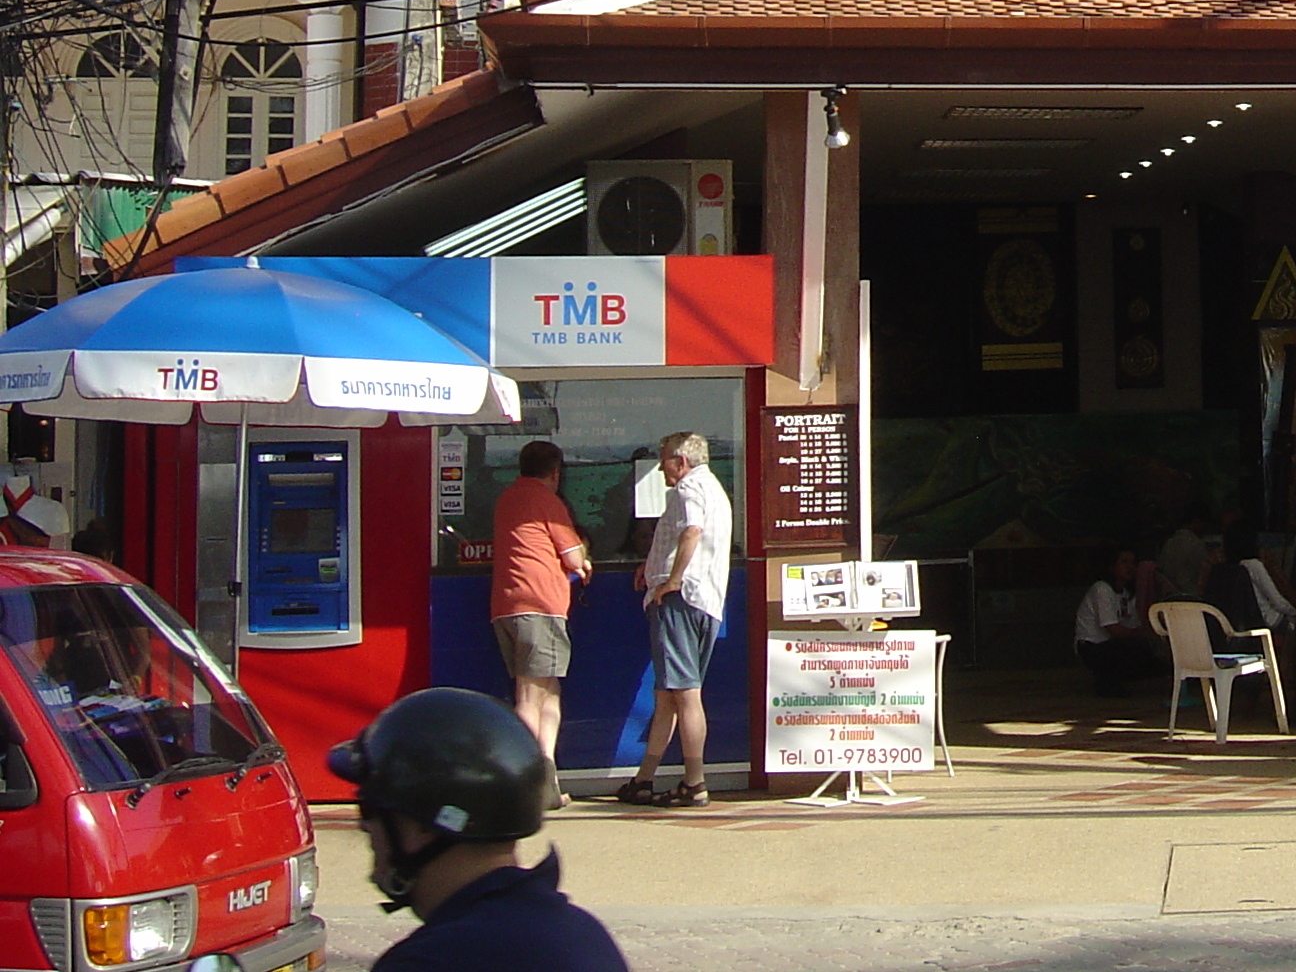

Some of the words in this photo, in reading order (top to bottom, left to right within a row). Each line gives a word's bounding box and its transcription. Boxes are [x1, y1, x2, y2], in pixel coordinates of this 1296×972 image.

[533, 291, 627, 326] TMB
[532, 332, 568, 345] TMB
[576, 332, 623, 345] BANK
[157, 364, 219, 392] TMB
[341, 377, 452, 401] ธนาคารทหารไทย
[775, 414, 846, 427] PORTRAIT
[783, 426, 799, 434] FOR
[443, 484, 461, 492] VISA
[443, 500, 461, 508] VISA
[464, 544, 494, 559] OPE
[829, 675, 836, 689] 5
[839, 673, 875, 688] ตำแหน่ง
[880, 693, 887, 705] 2
[890, 691, 925, 705] ตำแหน่ง
[829, 728, 836, 741] 2
[839, 726, 875, 741] ตำแหน่ง
[779, 749, 807, 765] Tel.
[814, 747, 922, 765] 01-9783900
[229, 880, 272, 912] HIJET
